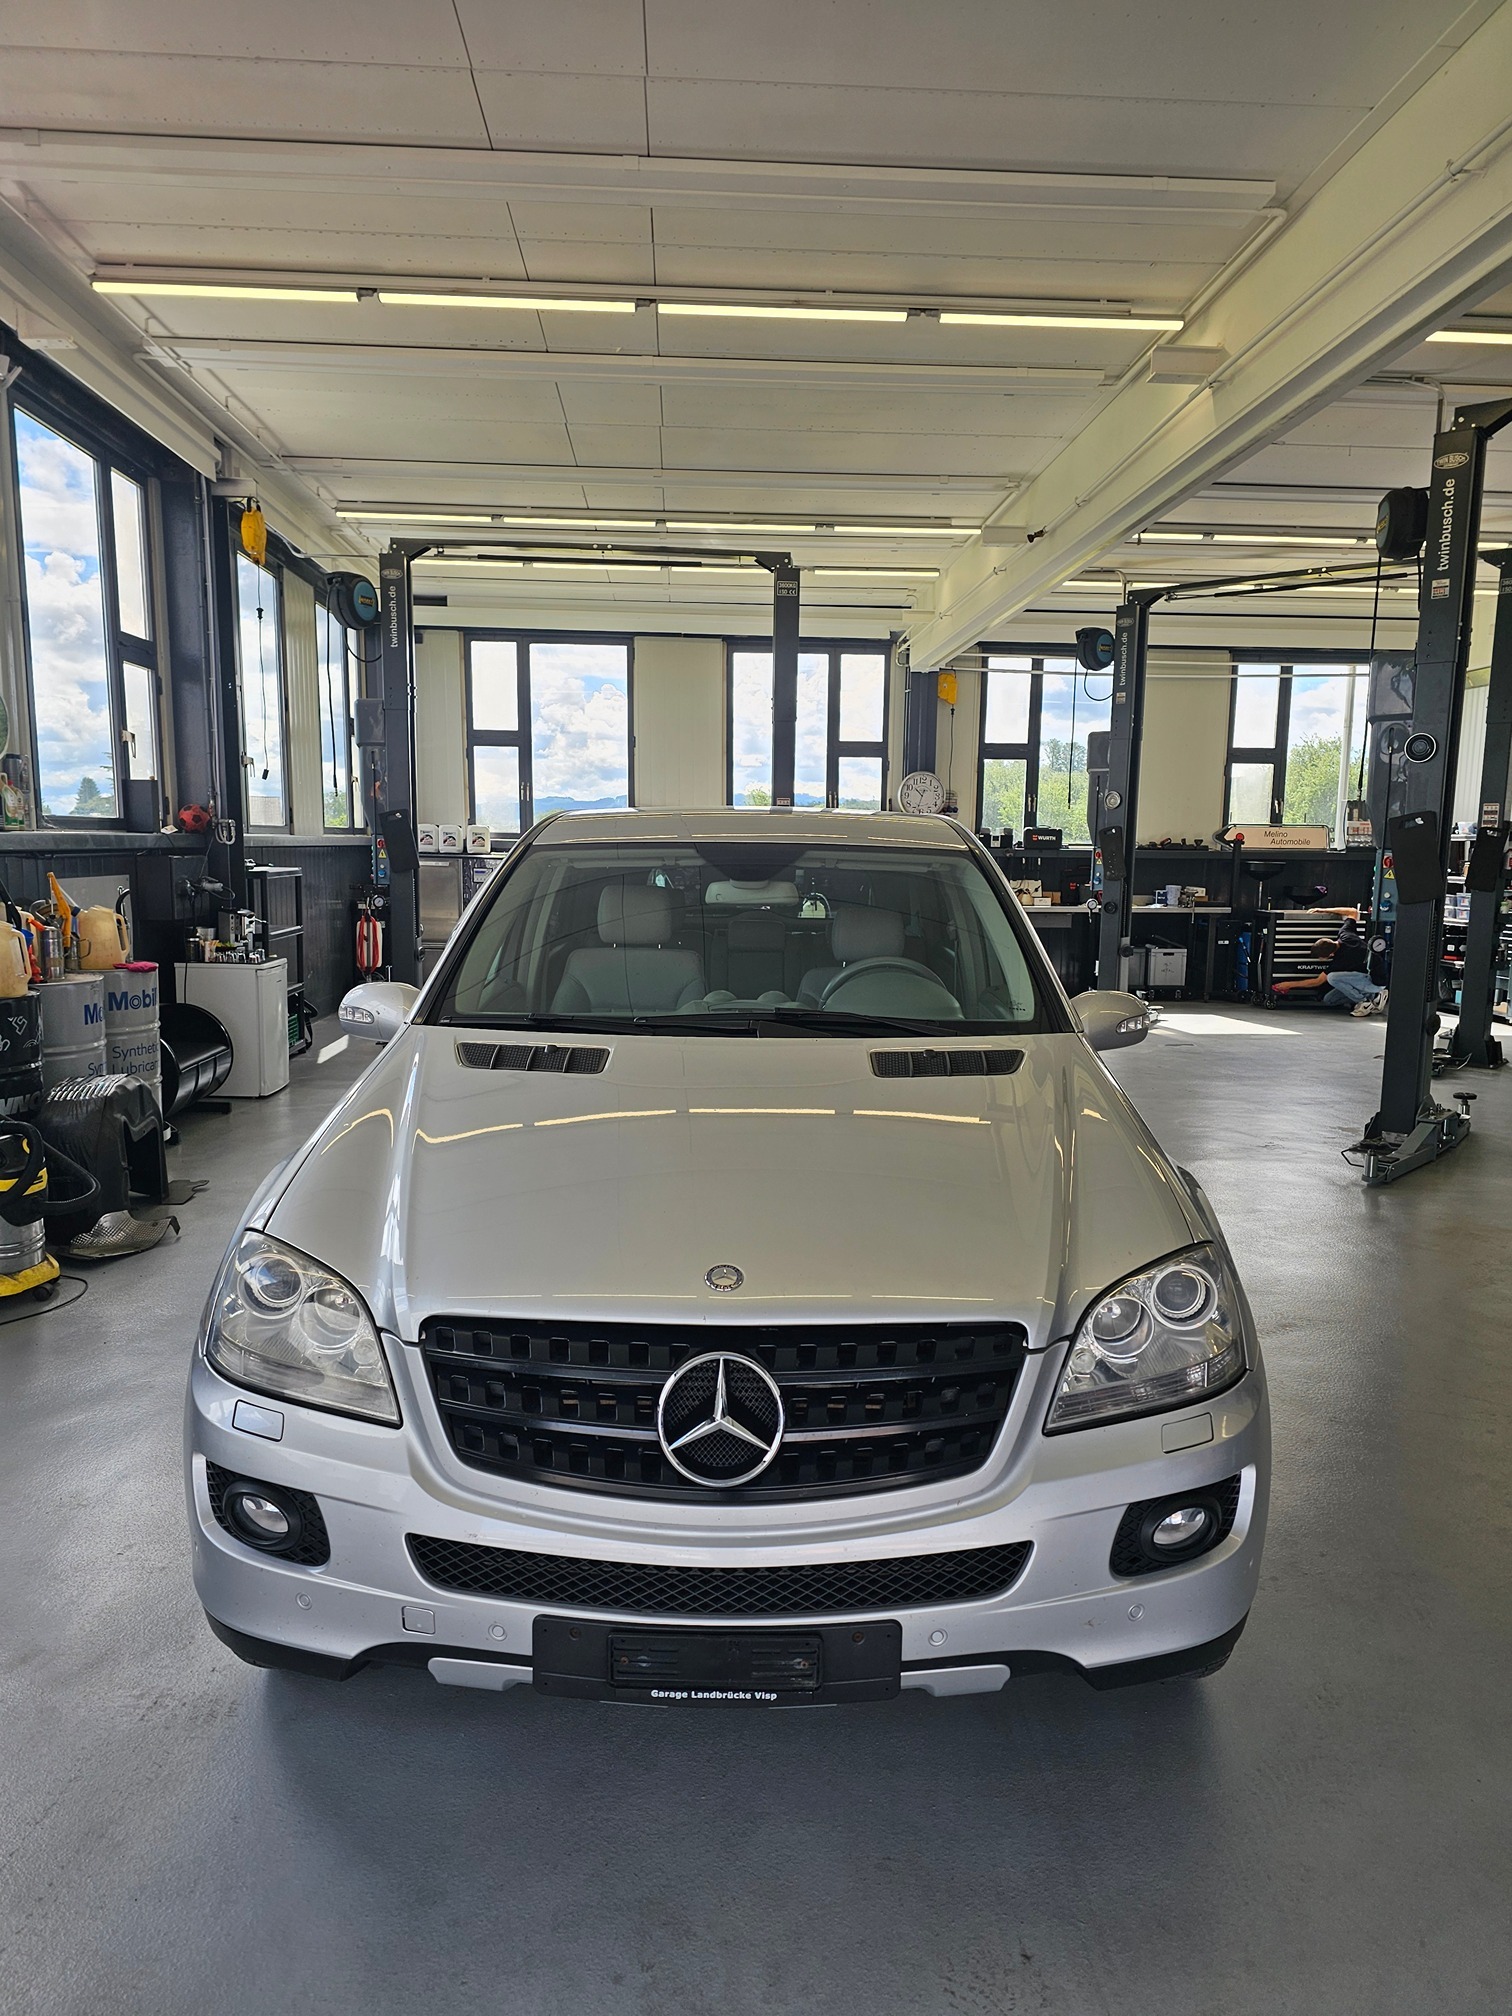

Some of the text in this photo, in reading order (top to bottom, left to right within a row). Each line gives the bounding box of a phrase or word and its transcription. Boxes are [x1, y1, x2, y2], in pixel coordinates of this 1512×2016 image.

[1437, 478, 1456, 572] twinbusch.de
[388, 586, 398, 648] twinbusch.de
[1119, 632, 1128, 686] twinbusch.de
[920, 775, 927, 783] 12
[108, 987, 157, 1011] Mobil
[650, 1690, 777, 1700] Garage Landbrücke Visp
